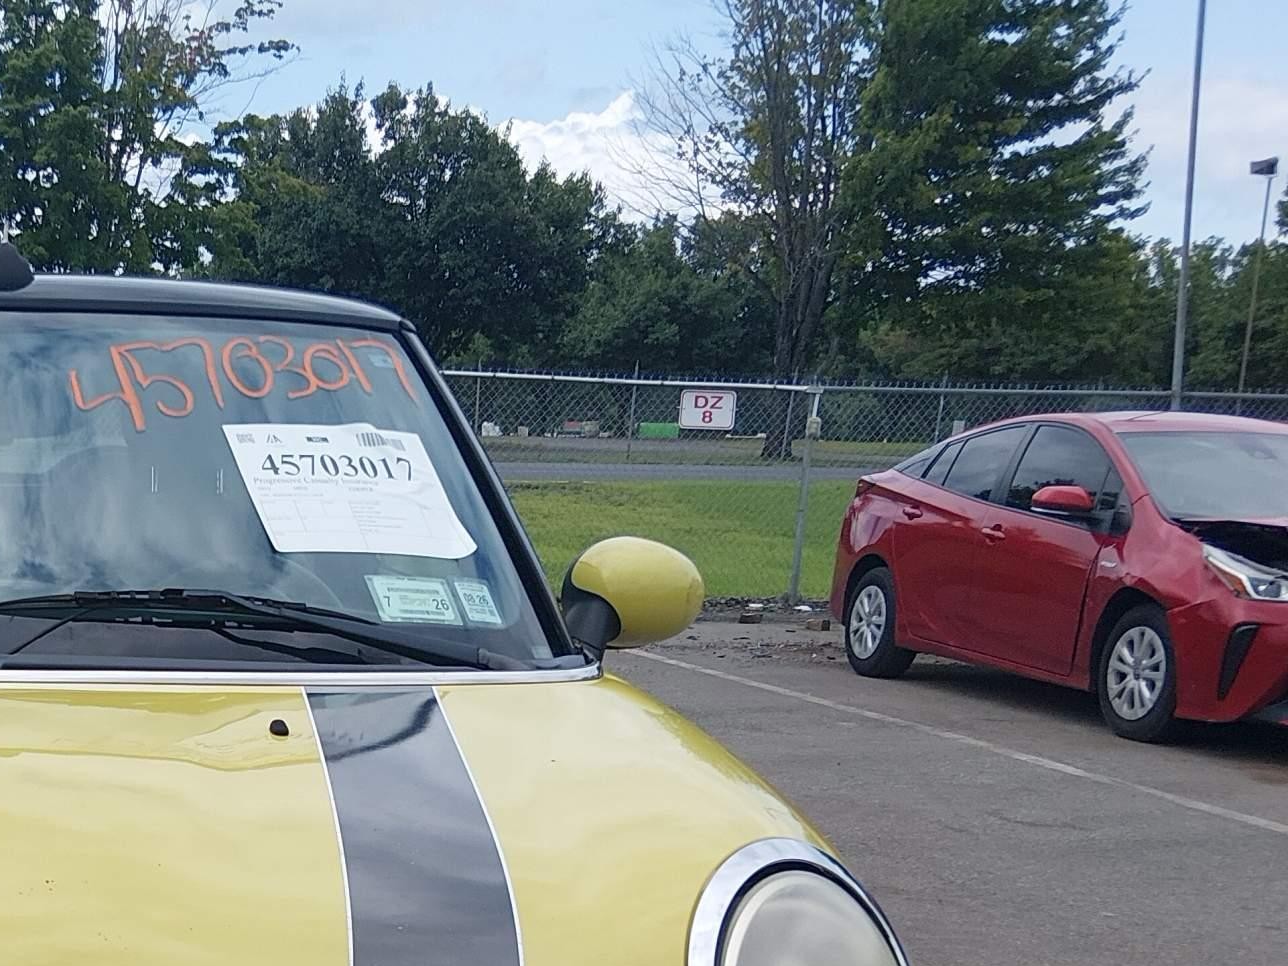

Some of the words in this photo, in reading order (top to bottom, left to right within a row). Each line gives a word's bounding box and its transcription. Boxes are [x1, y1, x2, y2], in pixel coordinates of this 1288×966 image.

[68, 335, 418, 432] 45703017
[694, 395, 724, 409] DZ
[702, 410, 713, 423] 8
[261, 453, 412, 481] 45703017
[383, 595, 391, 608] 7
[432, 598, 450, 611] 26
